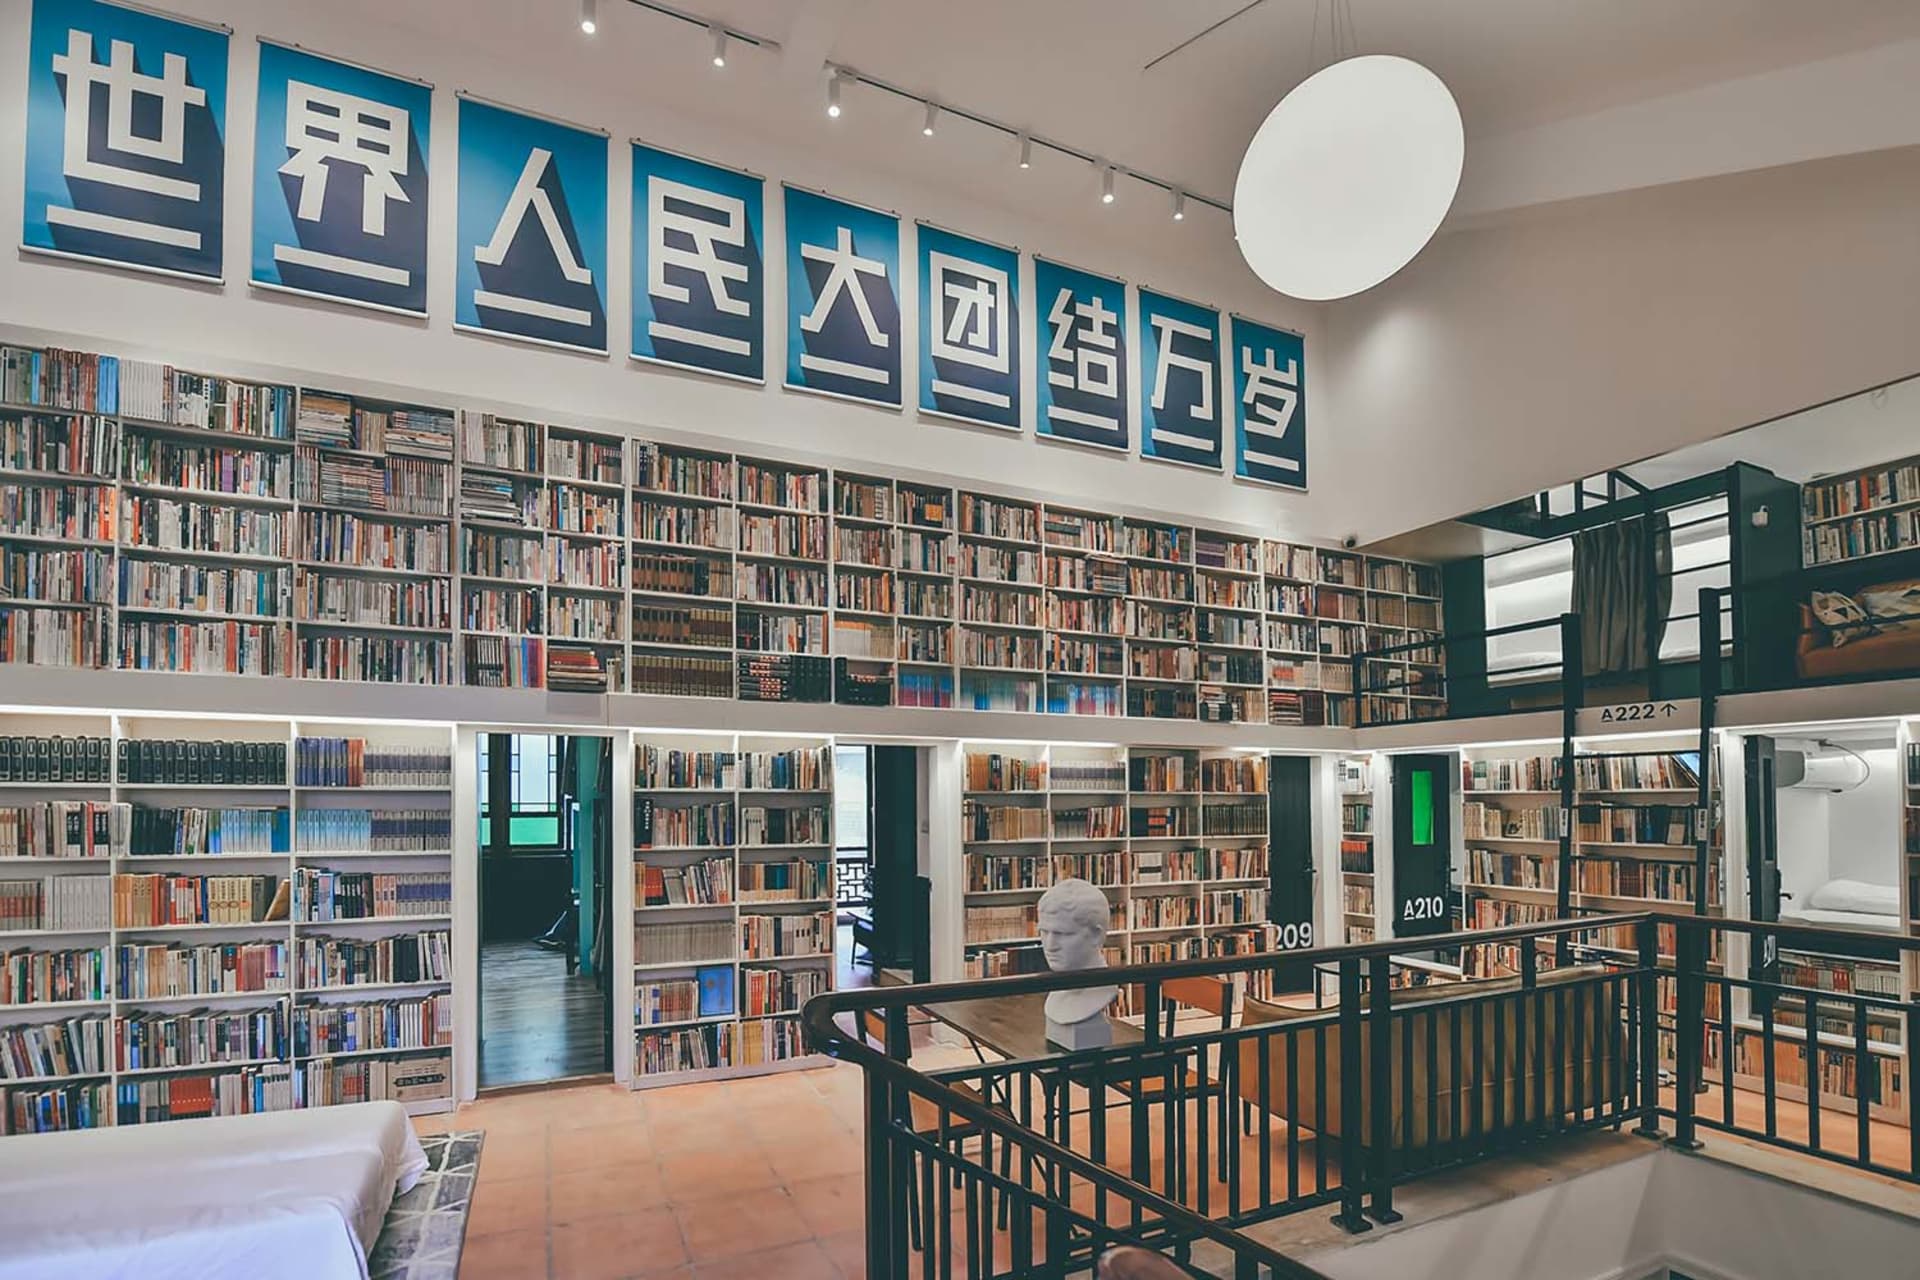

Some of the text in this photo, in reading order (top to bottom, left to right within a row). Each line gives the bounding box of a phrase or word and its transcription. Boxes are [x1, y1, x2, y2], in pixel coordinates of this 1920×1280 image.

[53, 29, 1298, 438] 世 界 人 民 大 团 结 万 岁
[1601, 703, 1655, 722] A222
[1403, 896, 1444, 920] A210
